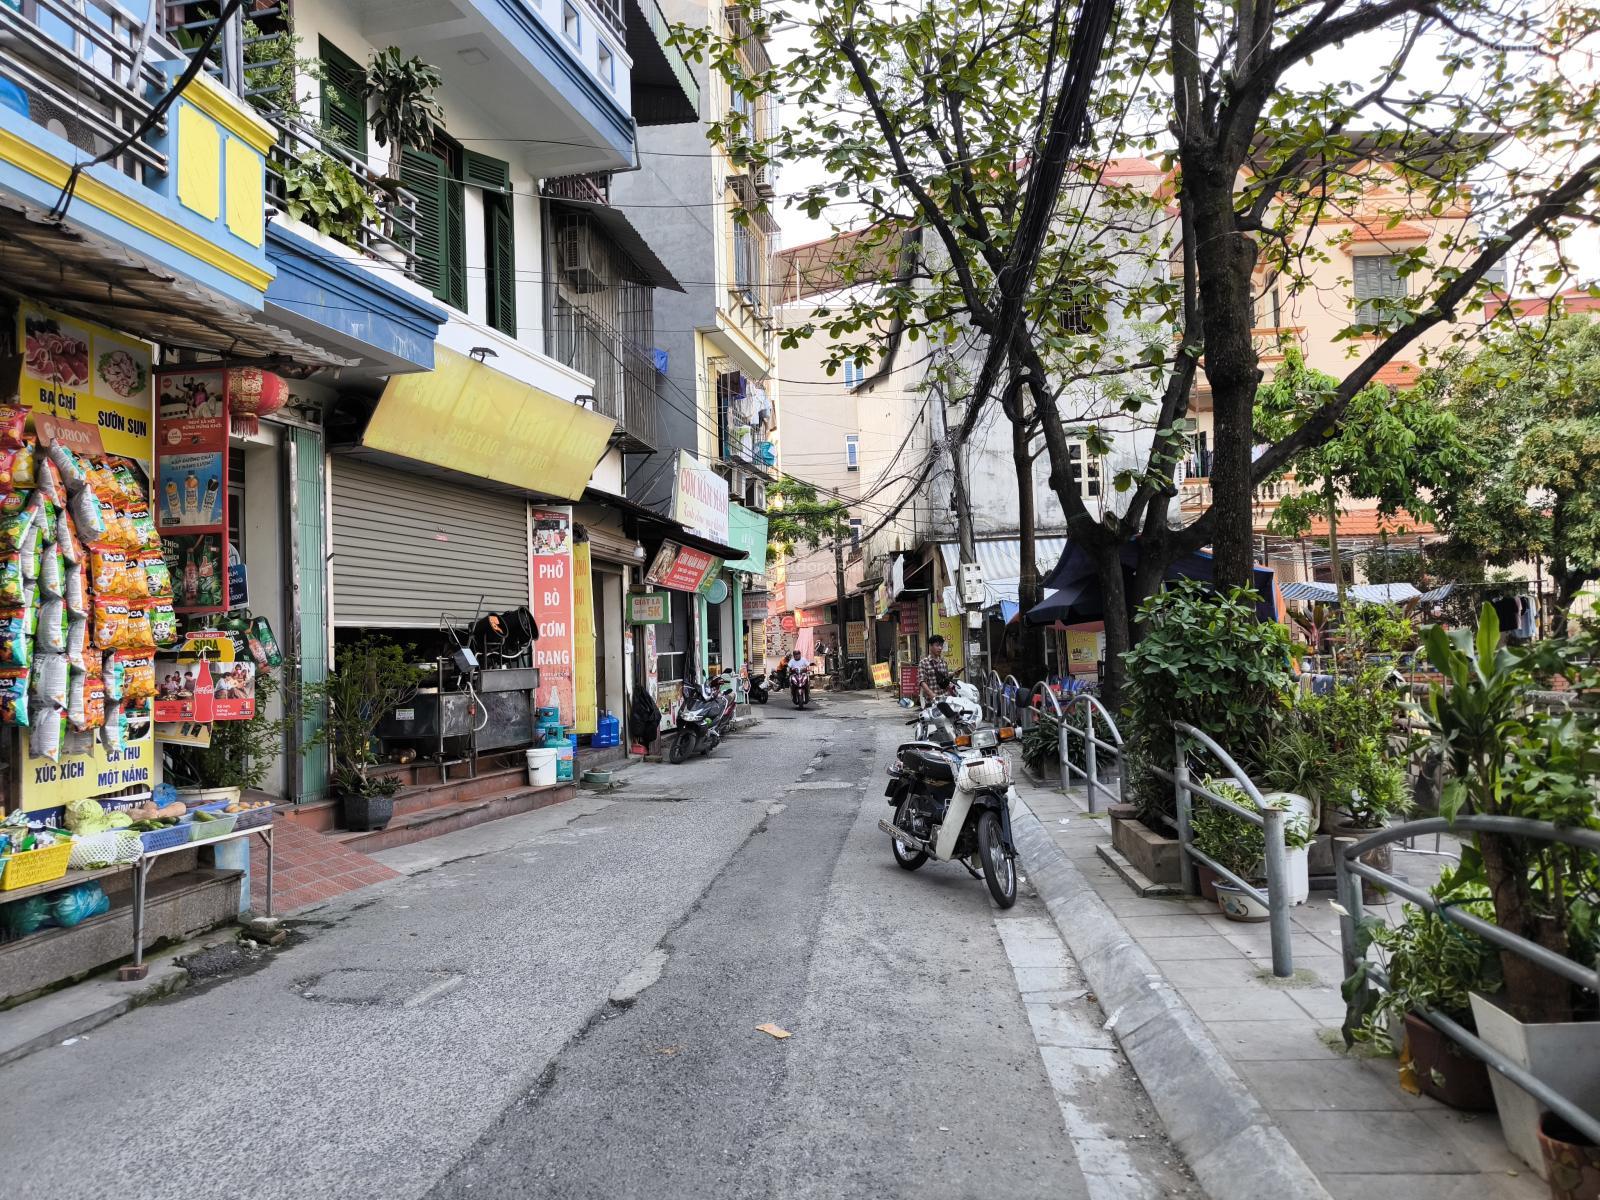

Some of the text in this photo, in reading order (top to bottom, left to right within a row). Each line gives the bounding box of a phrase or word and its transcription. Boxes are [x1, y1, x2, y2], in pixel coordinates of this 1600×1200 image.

[58, 393, 77, 410] CHỈ
[98, 410, 147, 438] SƯỜN SỤN
[57, 427, 90, 443] ORION
[539, 559, 564, 578] PHỞ
[544, 587, 560, 606] BÒ
[539, 620, 565, 637] CƠM
[194, 639, 219, 651] SODA
[122, 659, 148, 667] POCA
[537, 650, 570, 665] RANG
[123, 746, 140, 760] THU
[35, 760, 84, 783] XÚC XÍCH
[97, 764, 148, 787] MỘT NẮNG
